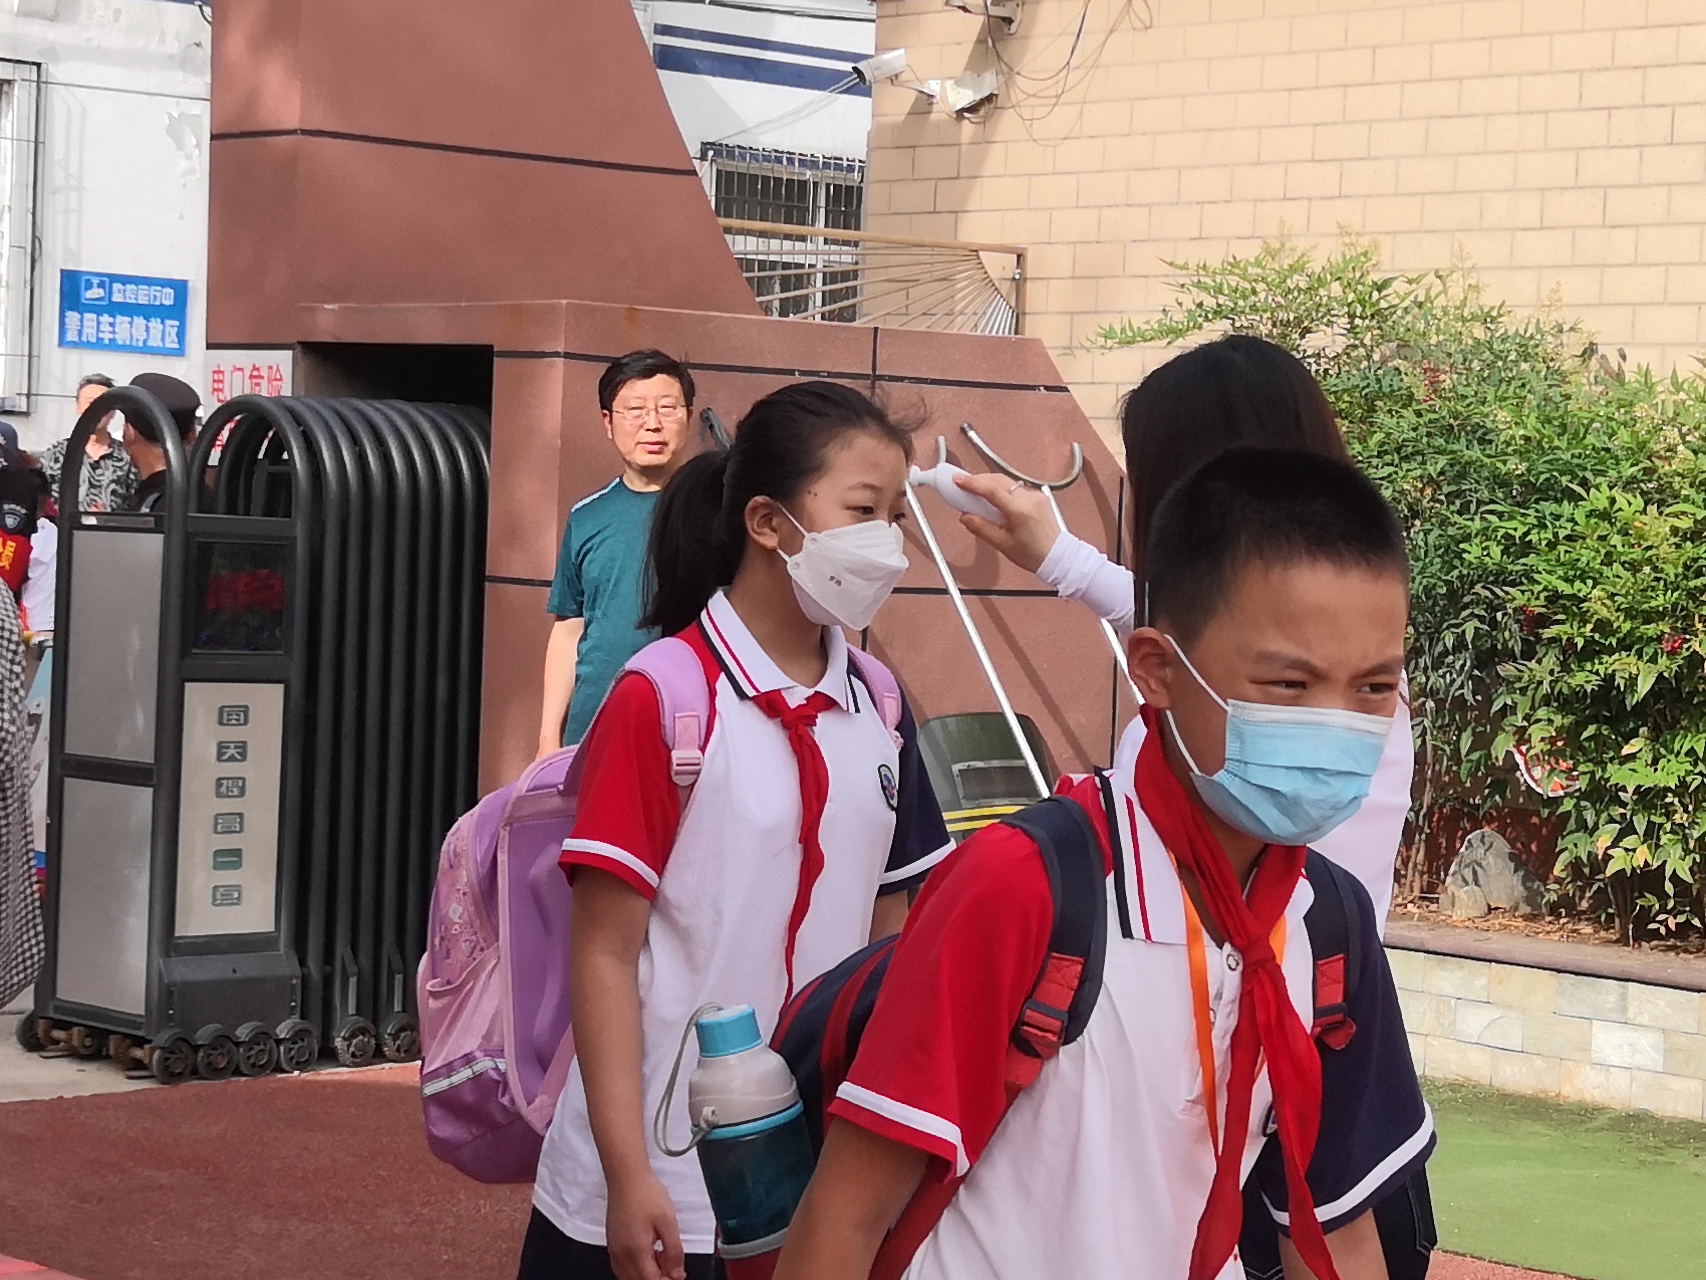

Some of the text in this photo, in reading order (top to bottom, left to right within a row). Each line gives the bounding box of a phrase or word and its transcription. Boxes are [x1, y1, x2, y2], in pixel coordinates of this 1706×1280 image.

[111, 282, 175, 306] 监控运行中
[63, 310, 180, 349] 警用车辆停放区
